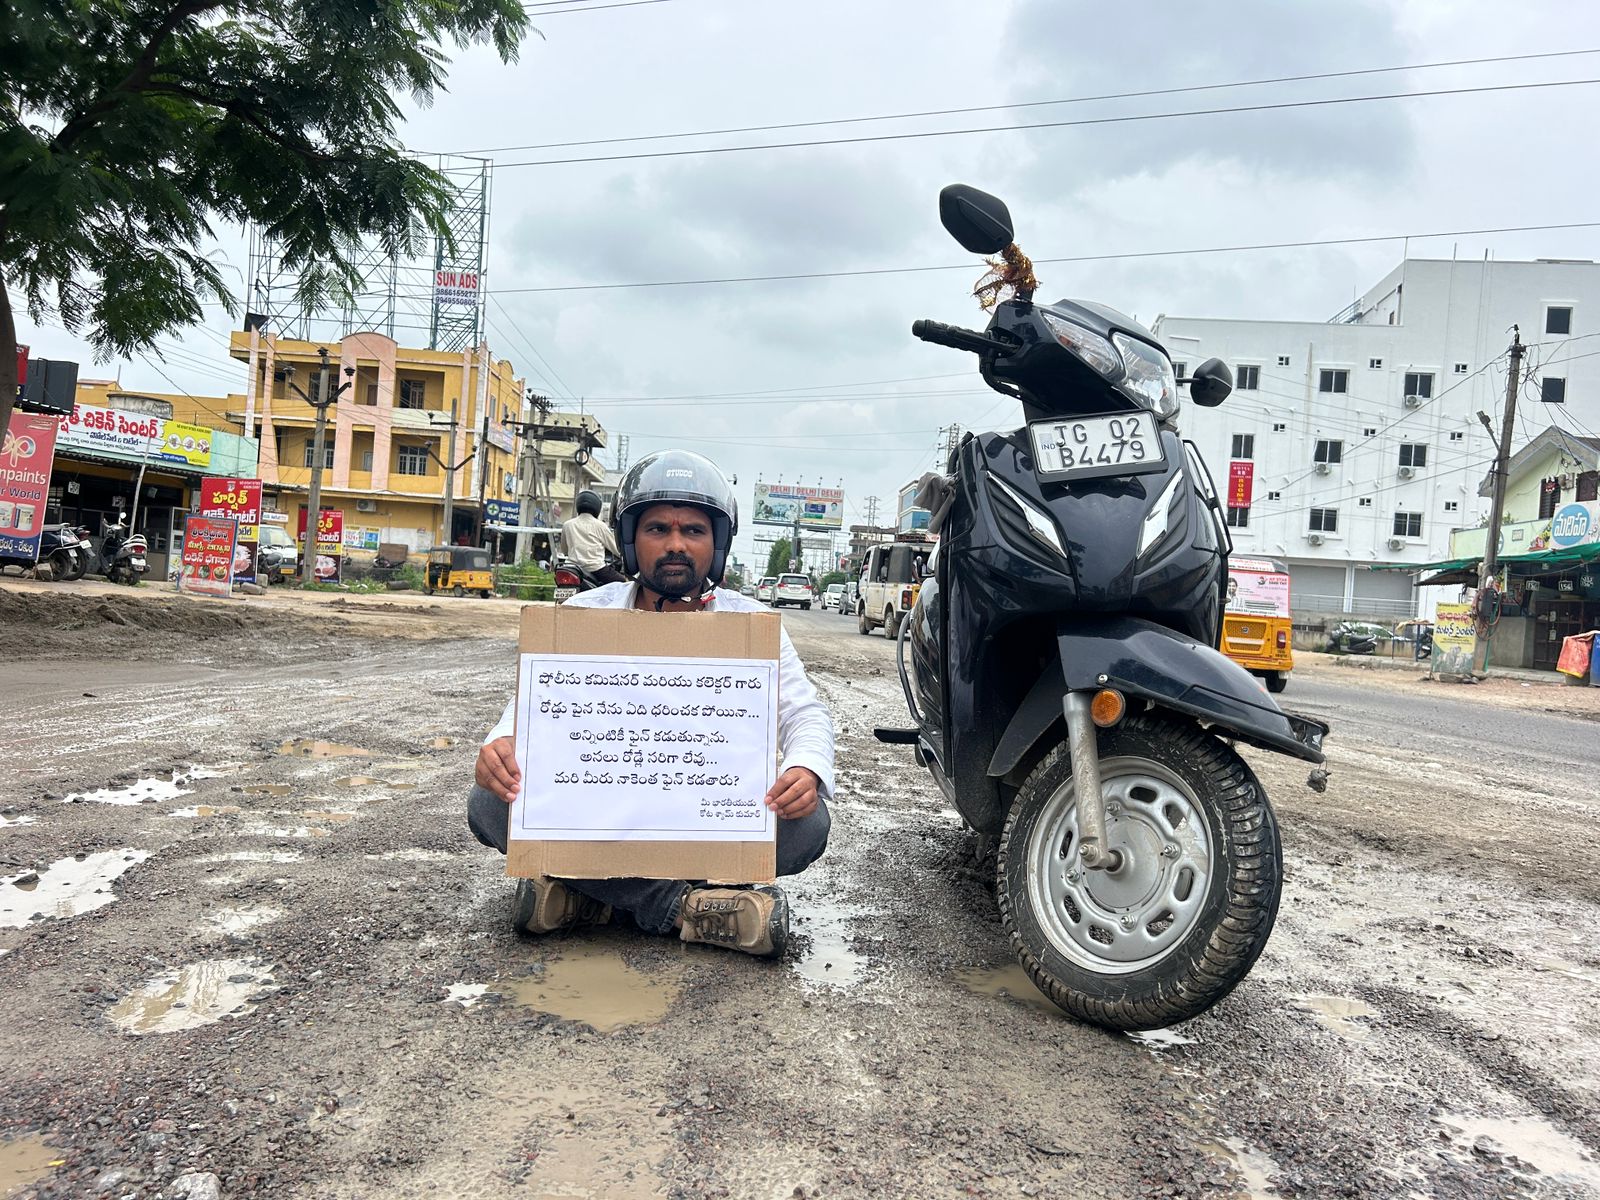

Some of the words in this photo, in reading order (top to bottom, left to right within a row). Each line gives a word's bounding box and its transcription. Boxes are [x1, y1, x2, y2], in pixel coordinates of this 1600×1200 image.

[437, 271, 456, 287] SUN
[459, 273, 478, 289] ADS
[83, 411, 115, 431] చికెన్
[118, 415, 158, 438] సెంటర్
[1054, 424, 1088, 444] TG
[1109, 417, 1144, 440] 02
[1059, 440, 1145, 468] B4479
[9, 487, 41, 501] World
[770, 485, 791, 493] DELHI
[796, 487, 817, 496] DELHI
[821, 489, 842, 498] DELHI
[585, 673, 639, 687] కమిషనర్
[642, 674, 692, 687] మరియు
[696, 676, 732, 694] కలెక్టర్
[735, 677, 762, 690] గారు
[540, 700, 567, 719] రోడ్డు
[571, 702, 593, 717] పైన
[596, 700, 623, 715] నేను
[626, 702, 648, 715] ఏది
[650, 703, 700, 717] ధరించక
[569, 727, 625, 745] అన్నింటికీ
[628, 729, 650, 747] ఫైన్
[653, 730, 729, 746] కడుతున్నాను.
[580, 750, 619, 762] అసలు
[622, 749, 644, 768] రోడ్లే
[647, 751, 679, 764] సరిగా
[554, 771, 579, 784] మరి
[582, 770, 614, 784] మీరు
[616, 773, 658, 785] నాకెంత
[662, 772, 684, 791] ఫైన్
[686, 773, 740, 787] కడతారు?
[736, 809, 761, 818] కుమార్
